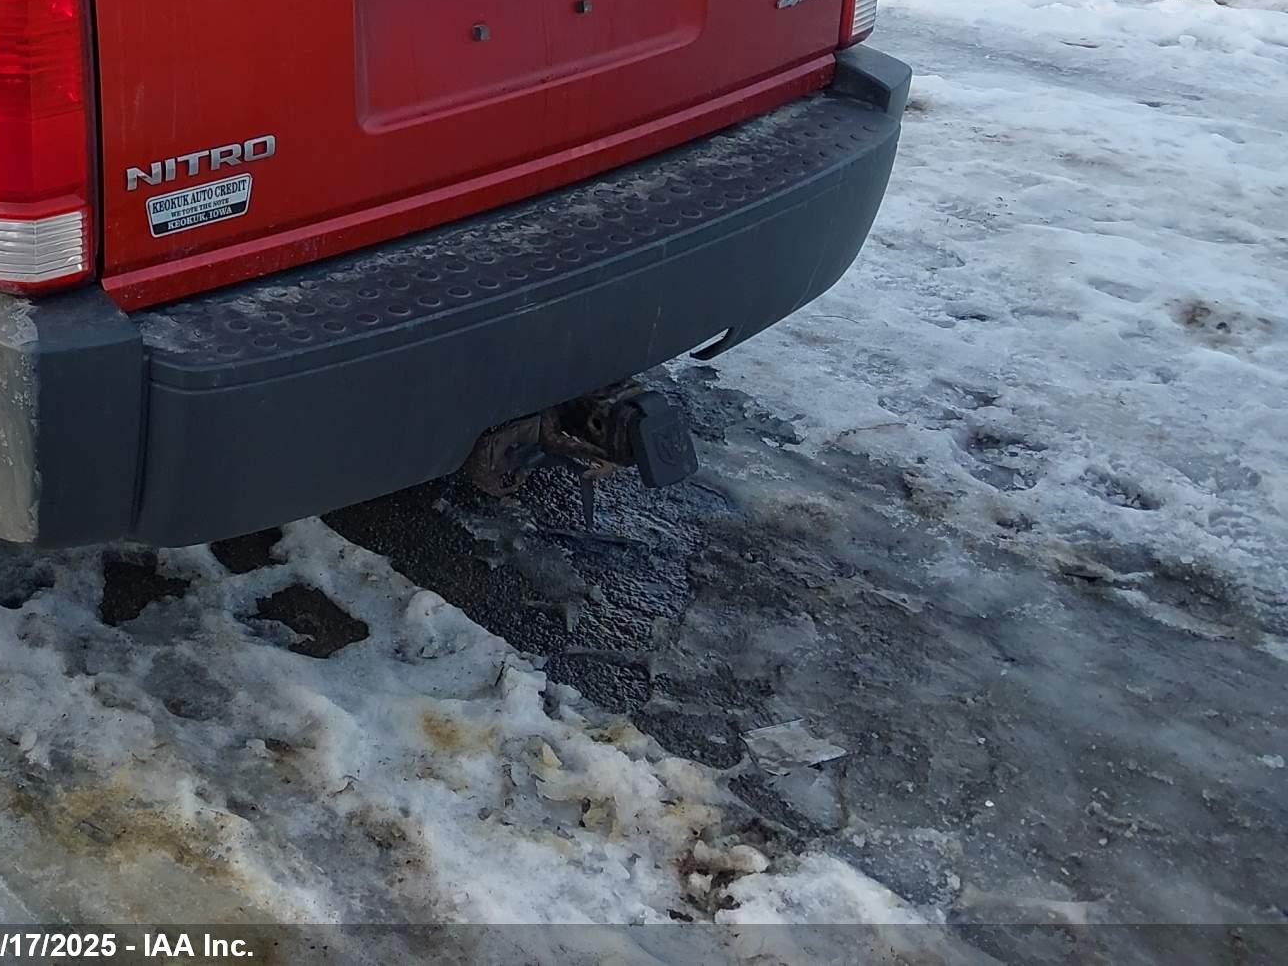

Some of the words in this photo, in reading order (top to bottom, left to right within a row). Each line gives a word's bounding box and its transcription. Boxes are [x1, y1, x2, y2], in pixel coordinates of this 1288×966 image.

[126, 134, 276, 191] NITRO
[152, 196, 190, 214] KEOKUK
[190, 188, 213, 204] AUTO
[214, 179, 247, 197] CREDIT
[212, 198, 230, 207] NOTE
[209, 206, 232, 219] IOWA
